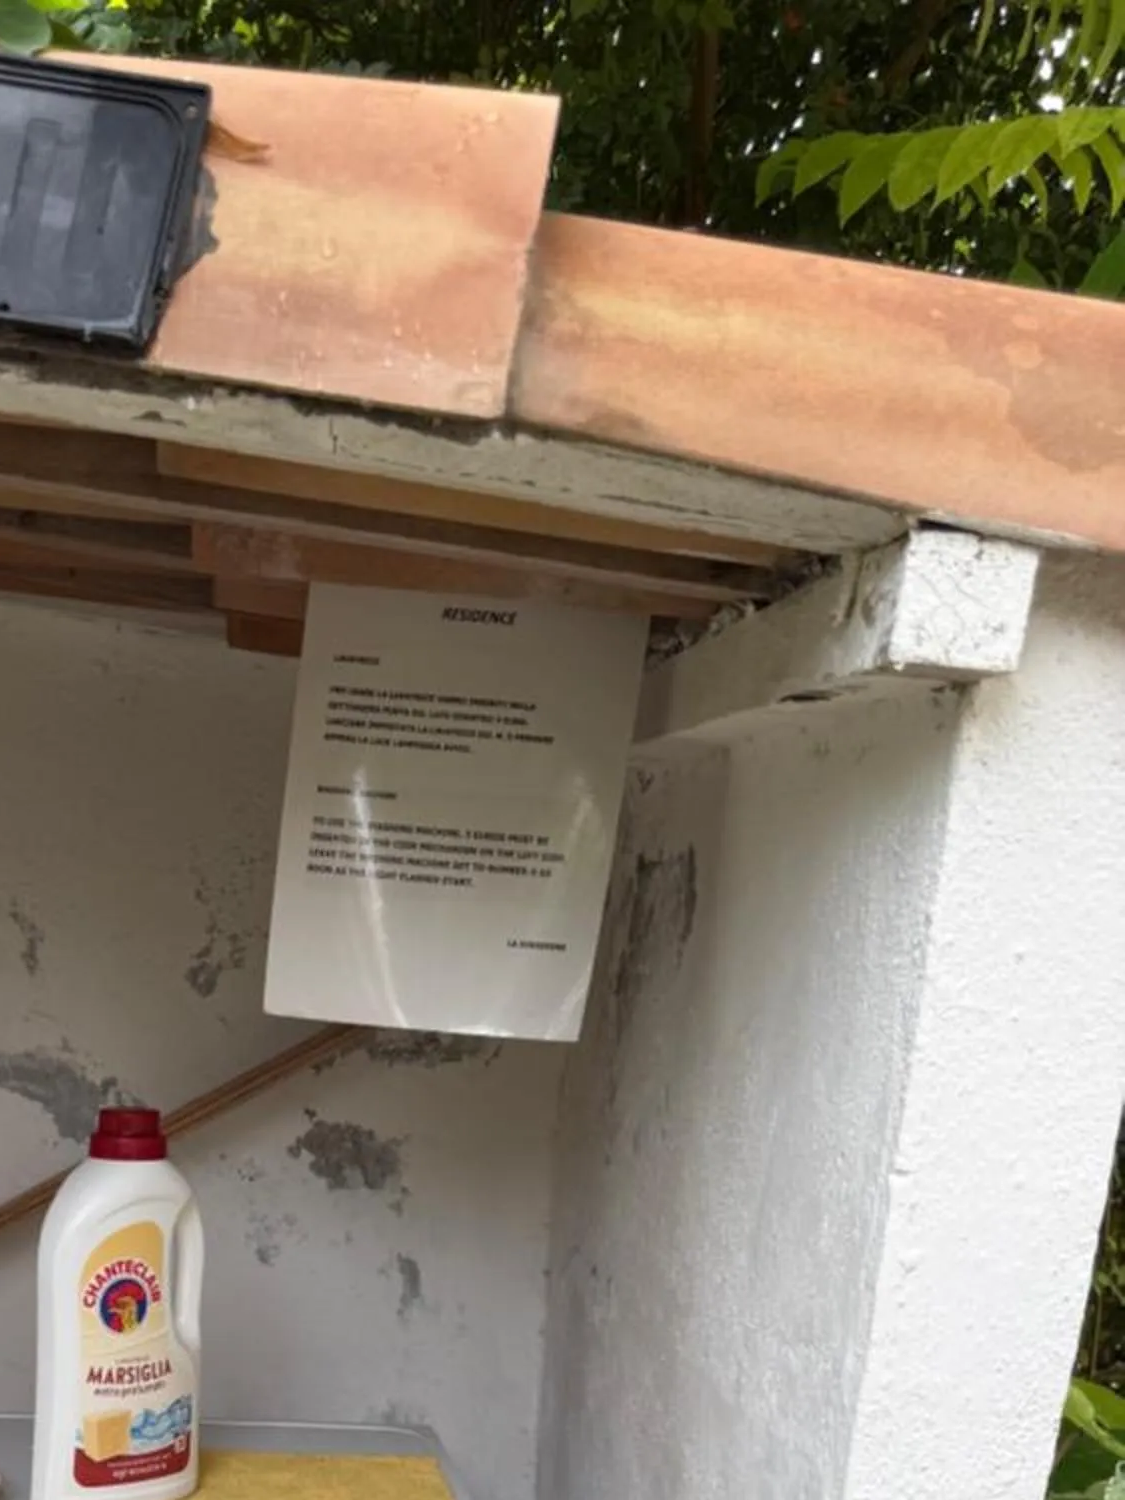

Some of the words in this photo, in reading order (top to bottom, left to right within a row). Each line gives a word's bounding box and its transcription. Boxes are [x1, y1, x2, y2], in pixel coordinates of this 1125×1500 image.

[442, 607, 517, 626] RESIDENCE
[83, 1259, 162, 1308] CHANTECLAIR
[86, 1358, 172, 1385] MARSIGLIA
